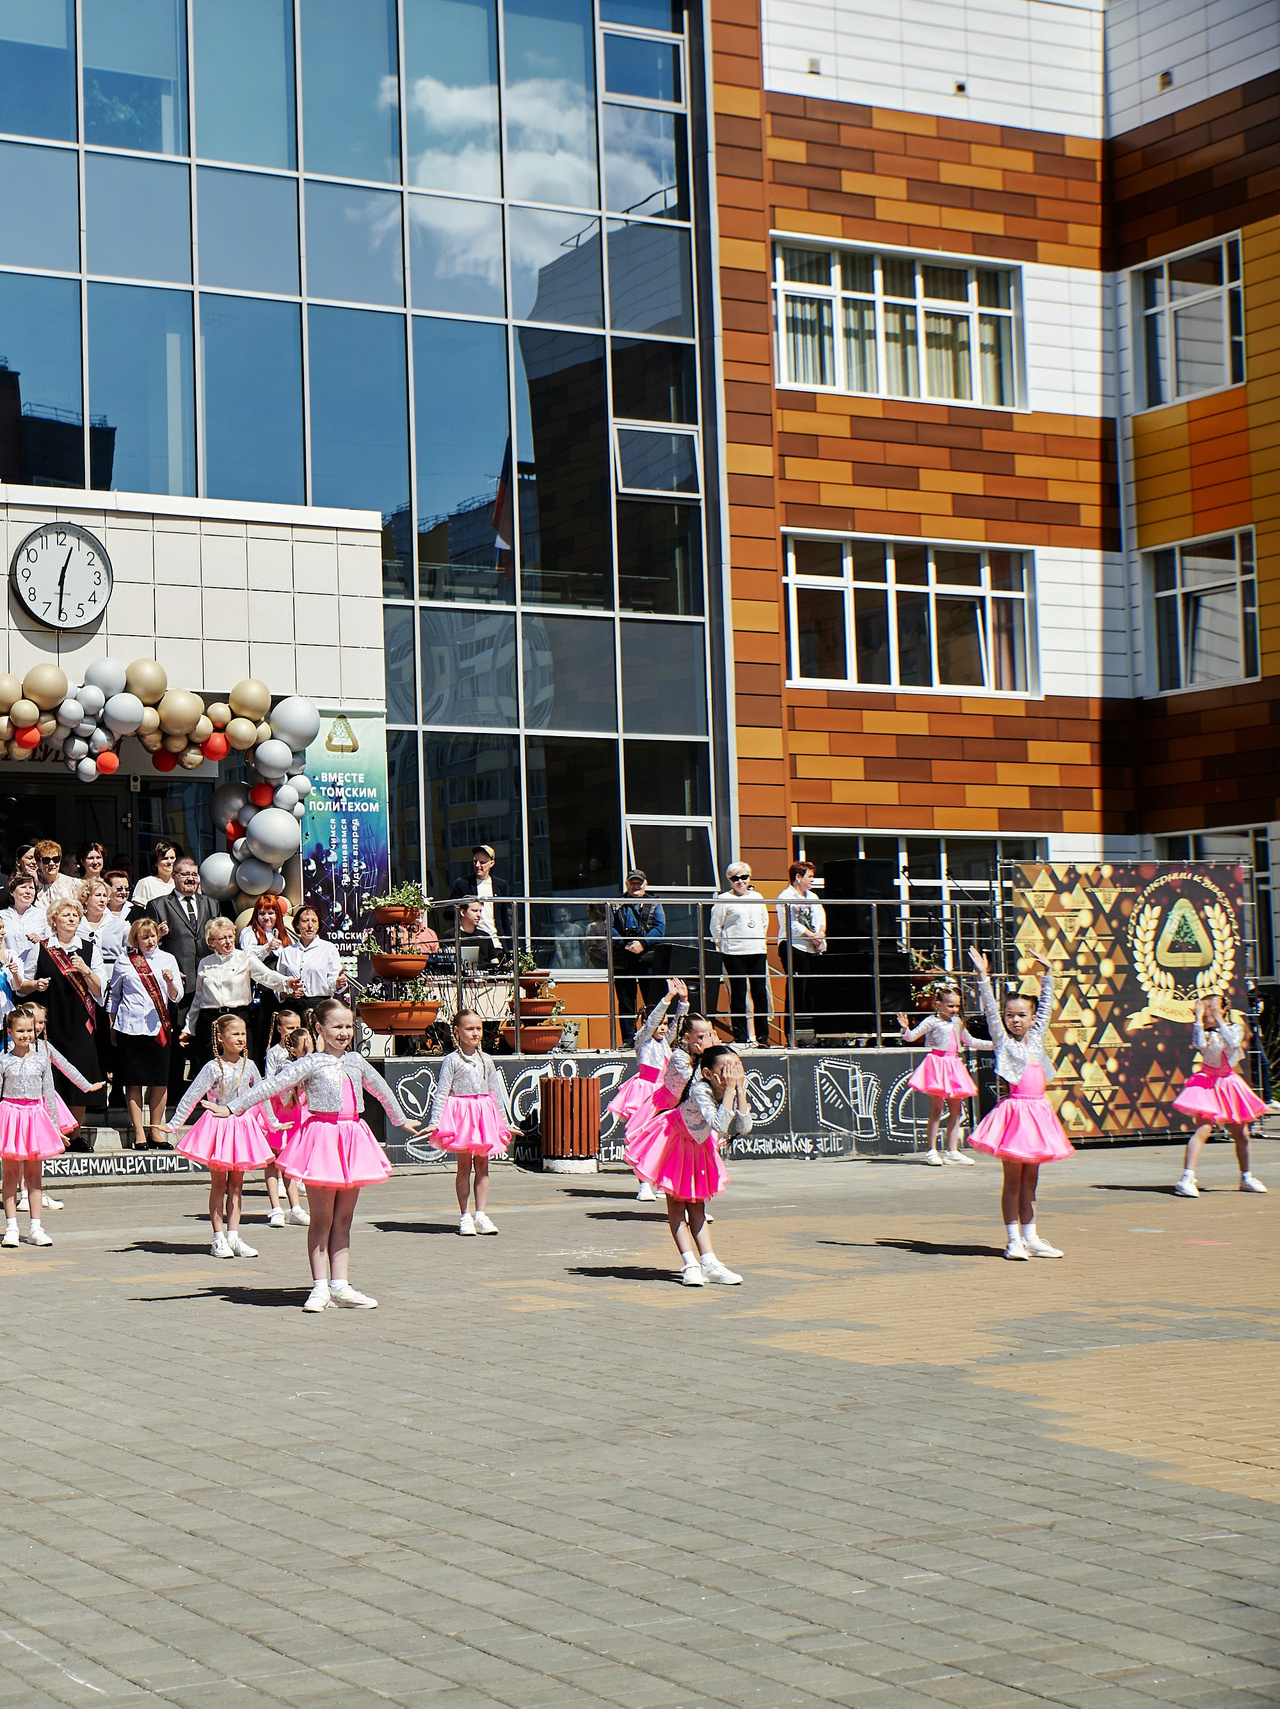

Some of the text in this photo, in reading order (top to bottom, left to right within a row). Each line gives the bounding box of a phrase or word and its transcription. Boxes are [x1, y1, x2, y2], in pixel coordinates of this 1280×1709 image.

[40, 535, 48, 550] 11
[55, 531, 67, 546] 12
[25, 547, 38, 563] 10
[86, 551, 96, 566] 2
[21, 568, 31, 582] 9
[93, 571, 102, 586] 3
[28, 587, 37, 601] 8
[87, 590, 97, 604] 4
[42, 601, 52, 616] 7
[59, 607, 68, 622] 6
[75, 603, 85, 618] 5
[321, 772, 365, 783] ВМЕСТЕ
[310, 786, 377, 798] С ТОМСКИМ
[309, 801, 379, 812] ПОЛИТЕХОМ
